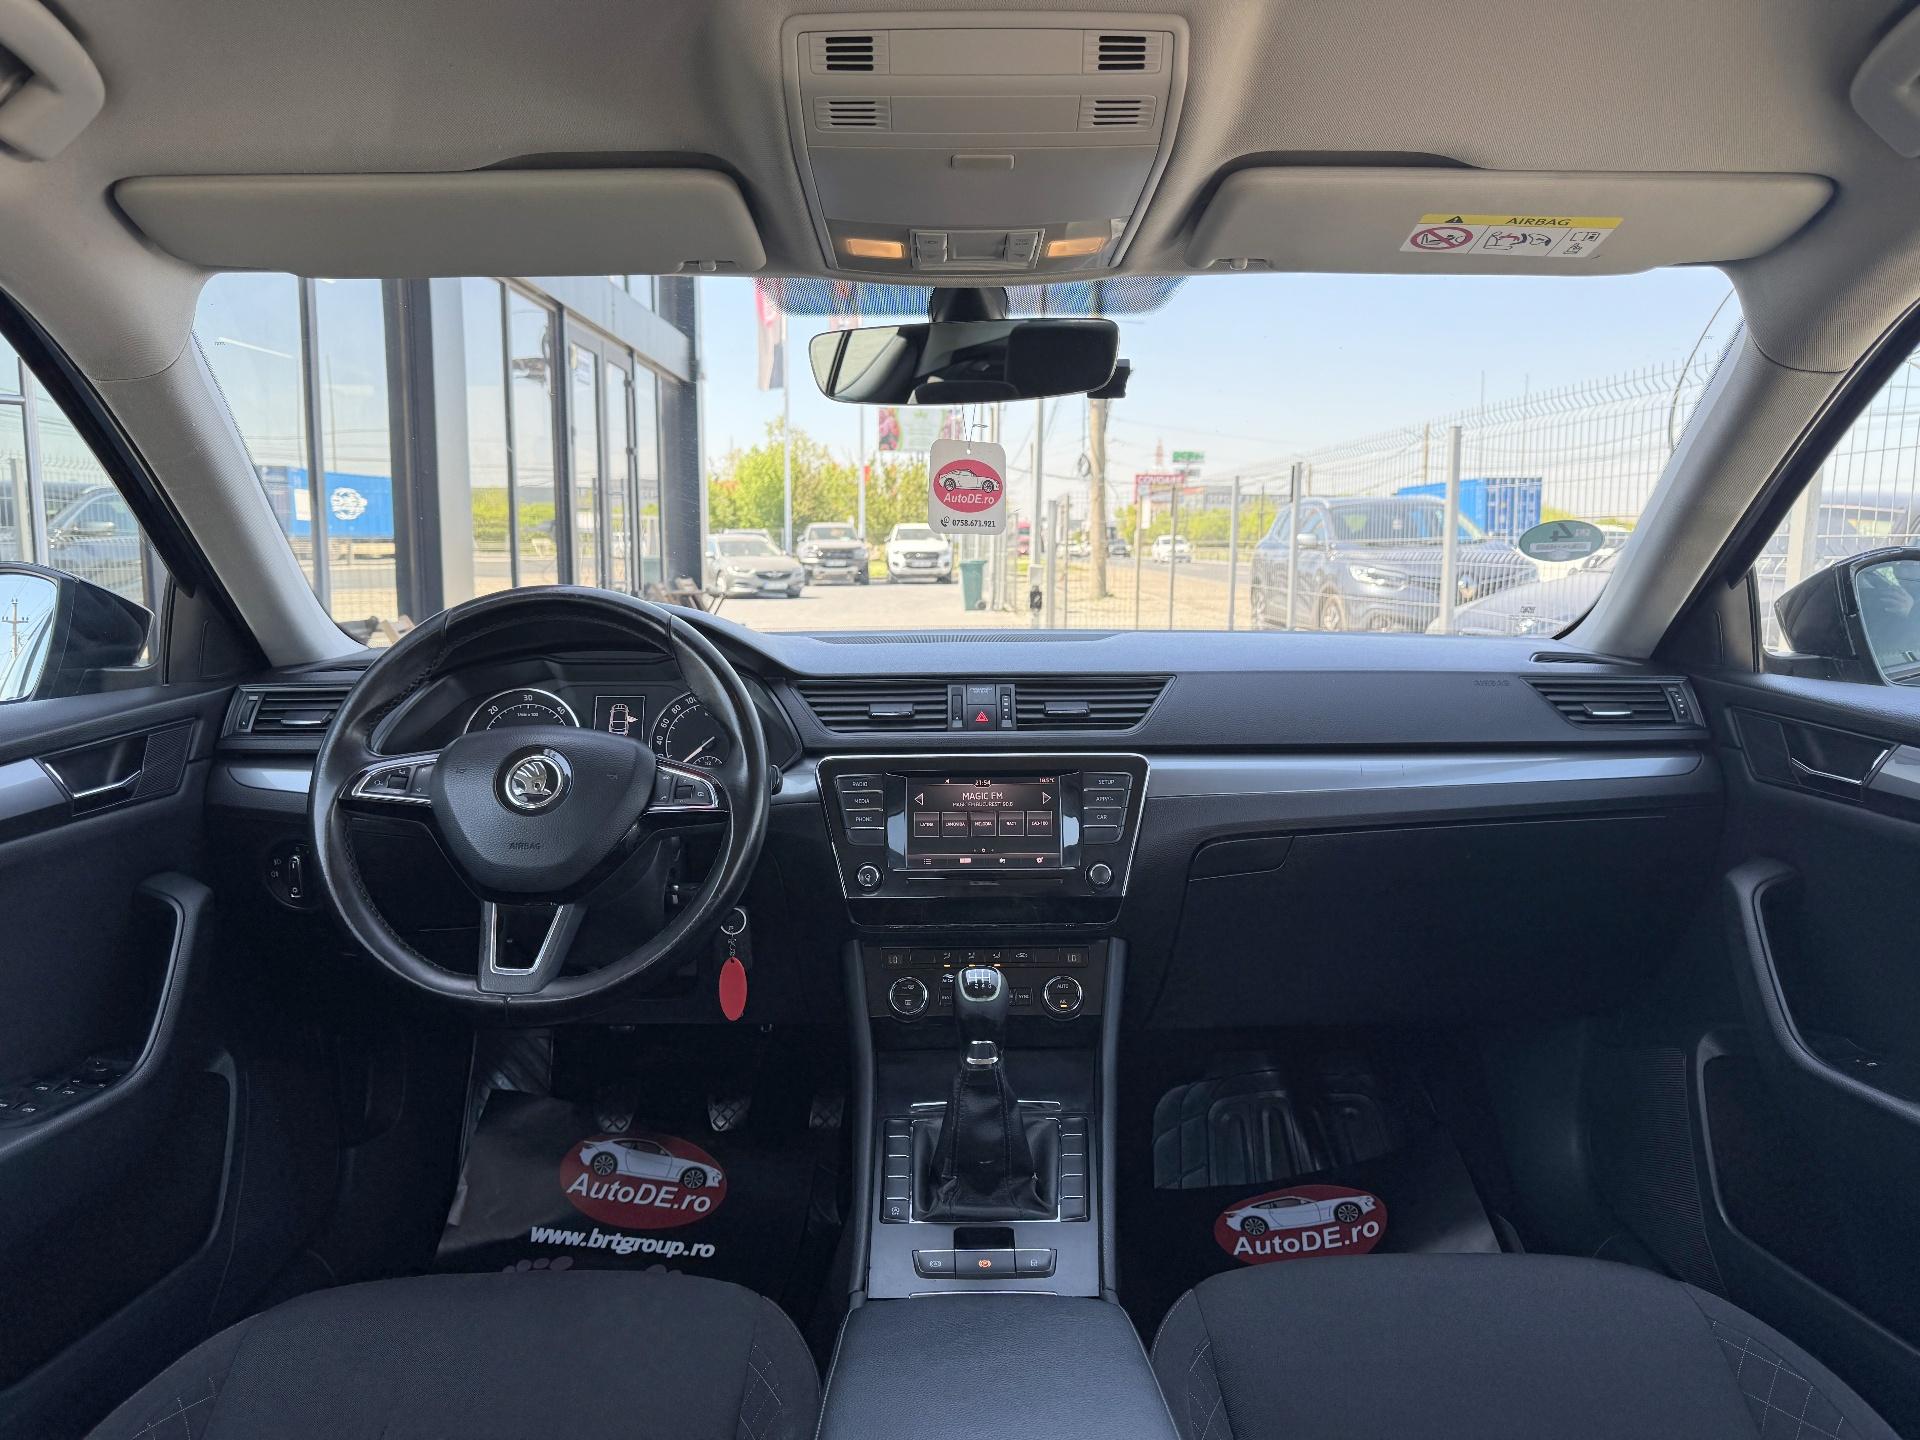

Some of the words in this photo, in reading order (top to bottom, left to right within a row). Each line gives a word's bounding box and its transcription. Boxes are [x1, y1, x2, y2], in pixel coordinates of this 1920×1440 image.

[1504, 216, 1572, 226] AIRBAG
[943, 492, 995, 505] AutoDE.ro
[952, 519, 996, 528] 0758.671.921
[487, 705, 499, 715] 20
[556, 705, 566, 715] 40
[671, 704, 682, 715] 80
[660, 718, 670, 729] 60
[656, 735, 664, 746] 40
[962, 791, 989, 801] MAGIC
[991, 791, 1003, 800] FM
[566, 1172, 712, 1213] AutoDE.ro
[530, 1226, 716, 1259] www.brtgroup.ro
[1232, 1220, 1380, 1256] AutoDE.ro
